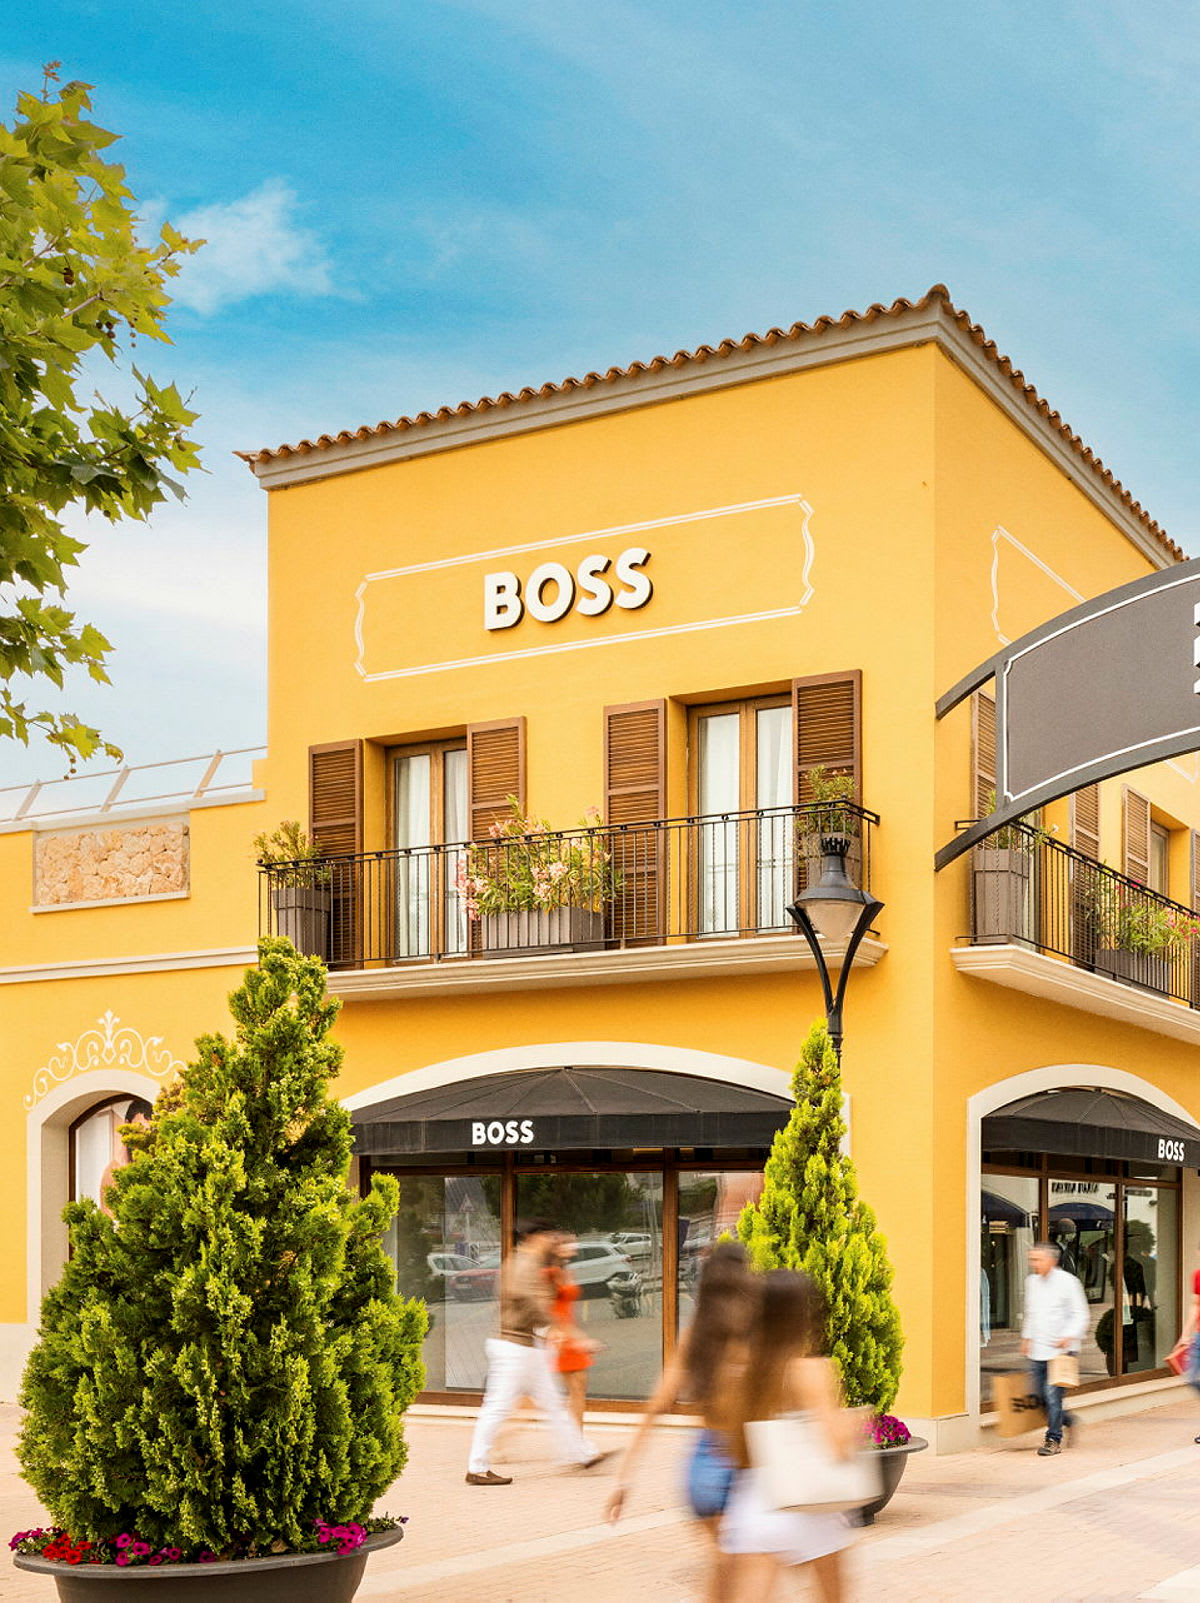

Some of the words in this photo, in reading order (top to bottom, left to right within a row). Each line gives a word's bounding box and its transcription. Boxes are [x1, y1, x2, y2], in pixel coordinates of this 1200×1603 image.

[484, 547, 653, 631] BOSS
[472, 1120, 534, 1145] BOSS
[1158, 1138, 1185, 1162] BOSS
